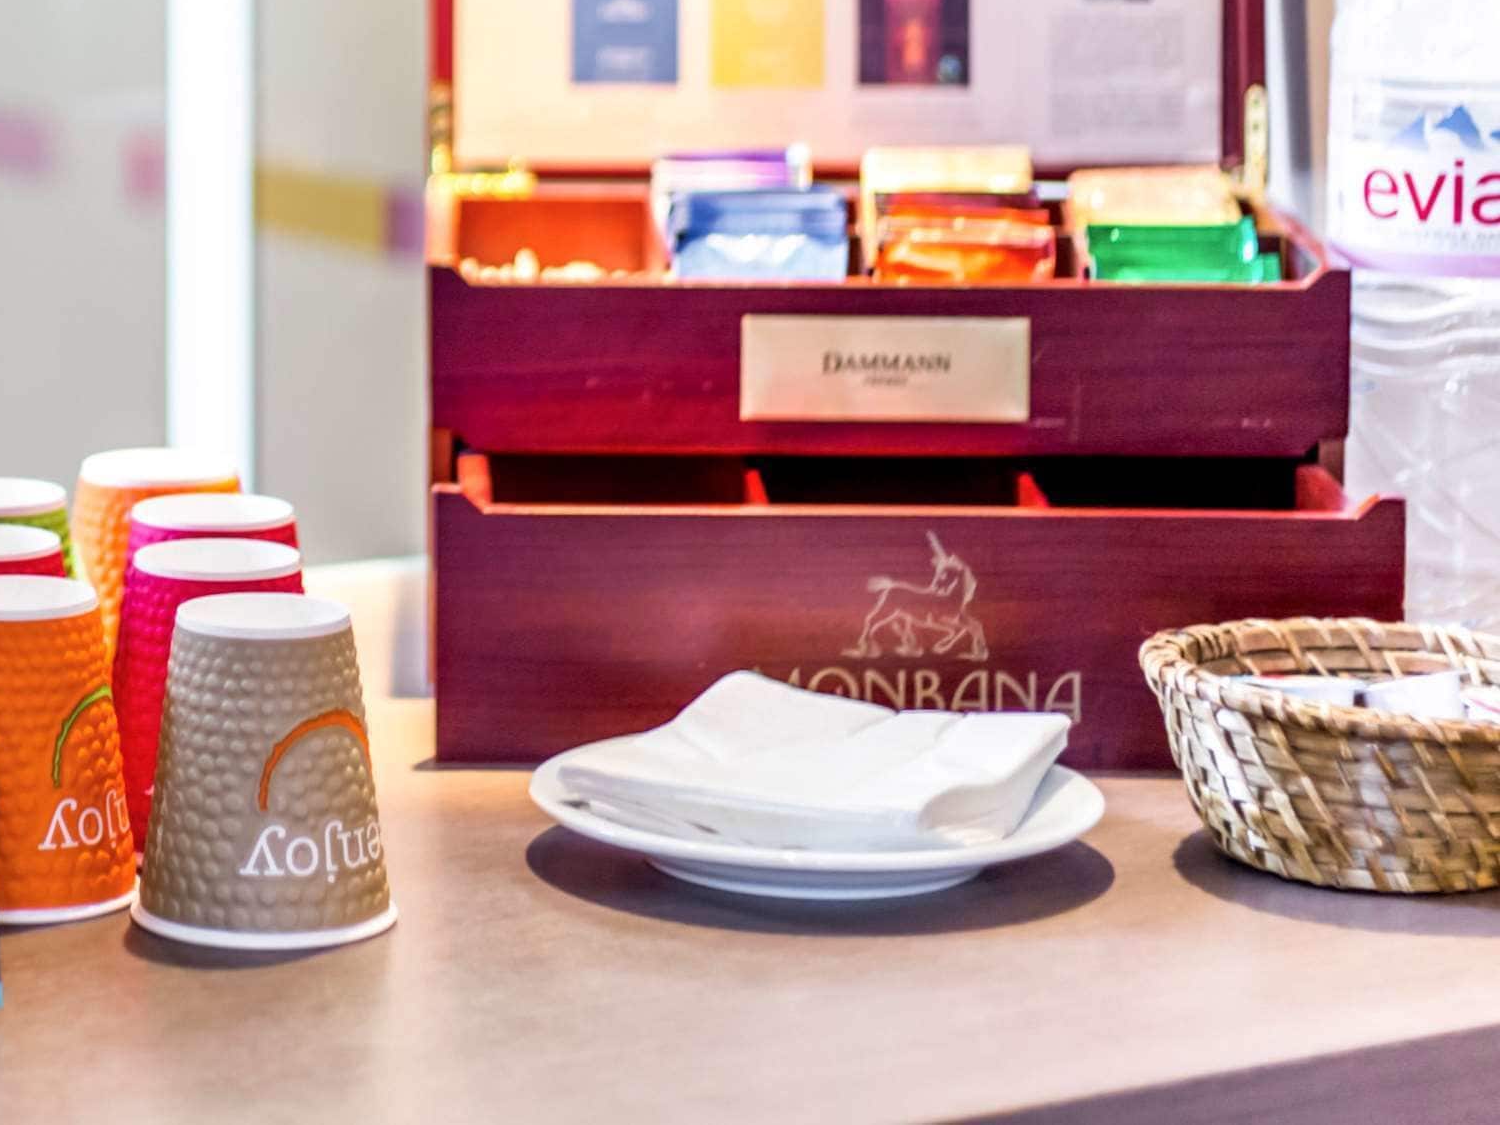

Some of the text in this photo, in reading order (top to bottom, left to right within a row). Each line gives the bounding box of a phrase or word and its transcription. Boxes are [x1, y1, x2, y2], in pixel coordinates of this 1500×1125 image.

[1363, 158, 1500, 226] evia
[821, 349, 952, 375] DAMMANN
[752, 666, 1082, 724] ONBANA
[241, 819, 382, 883] enjoy
